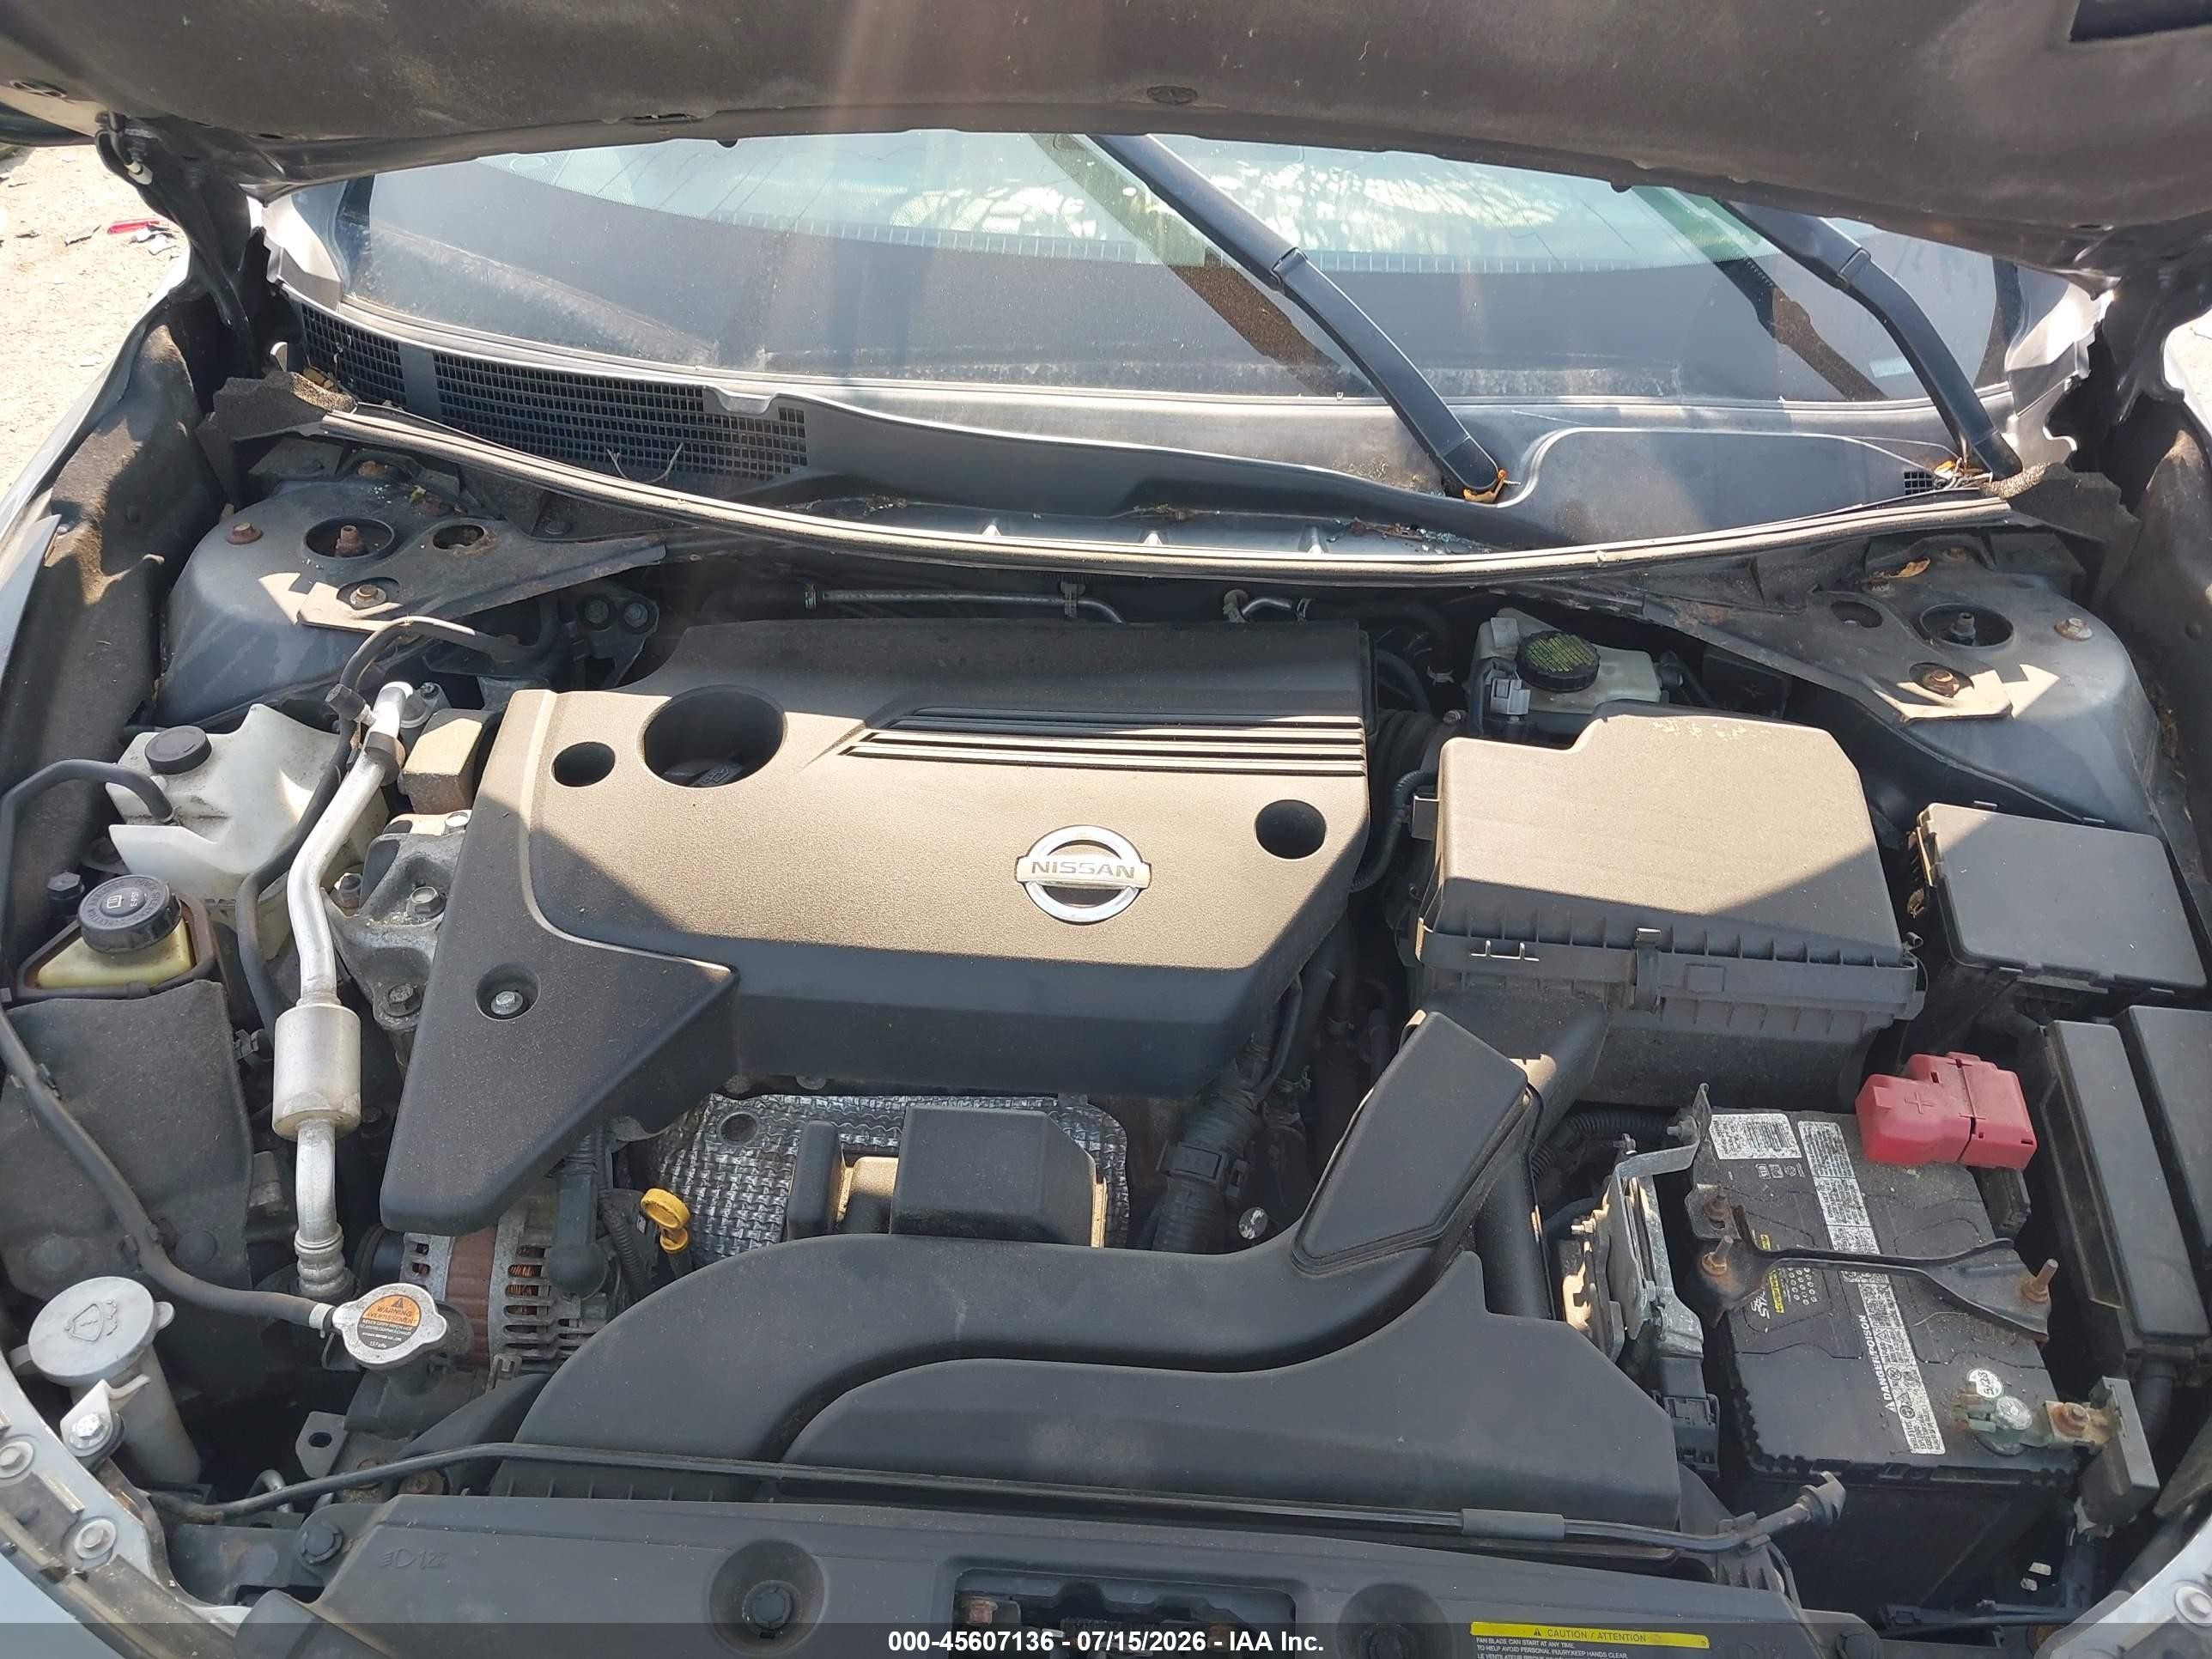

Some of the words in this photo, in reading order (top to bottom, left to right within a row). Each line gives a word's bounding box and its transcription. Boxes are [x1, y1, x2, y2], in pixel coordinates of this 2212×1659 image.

[1031, 861, 1135, 879] NISSAN
[377, 1305, 412, 1317] WARNING
[365, 1312, 416, 1325] AVERTISSEMENT
[1858, 1314, 1892, 1401] DANGER/POISON
[1547, 1629, 1587, 1639] CAUTION
[1597, 1632, 1646, 1642] ATTENTION
